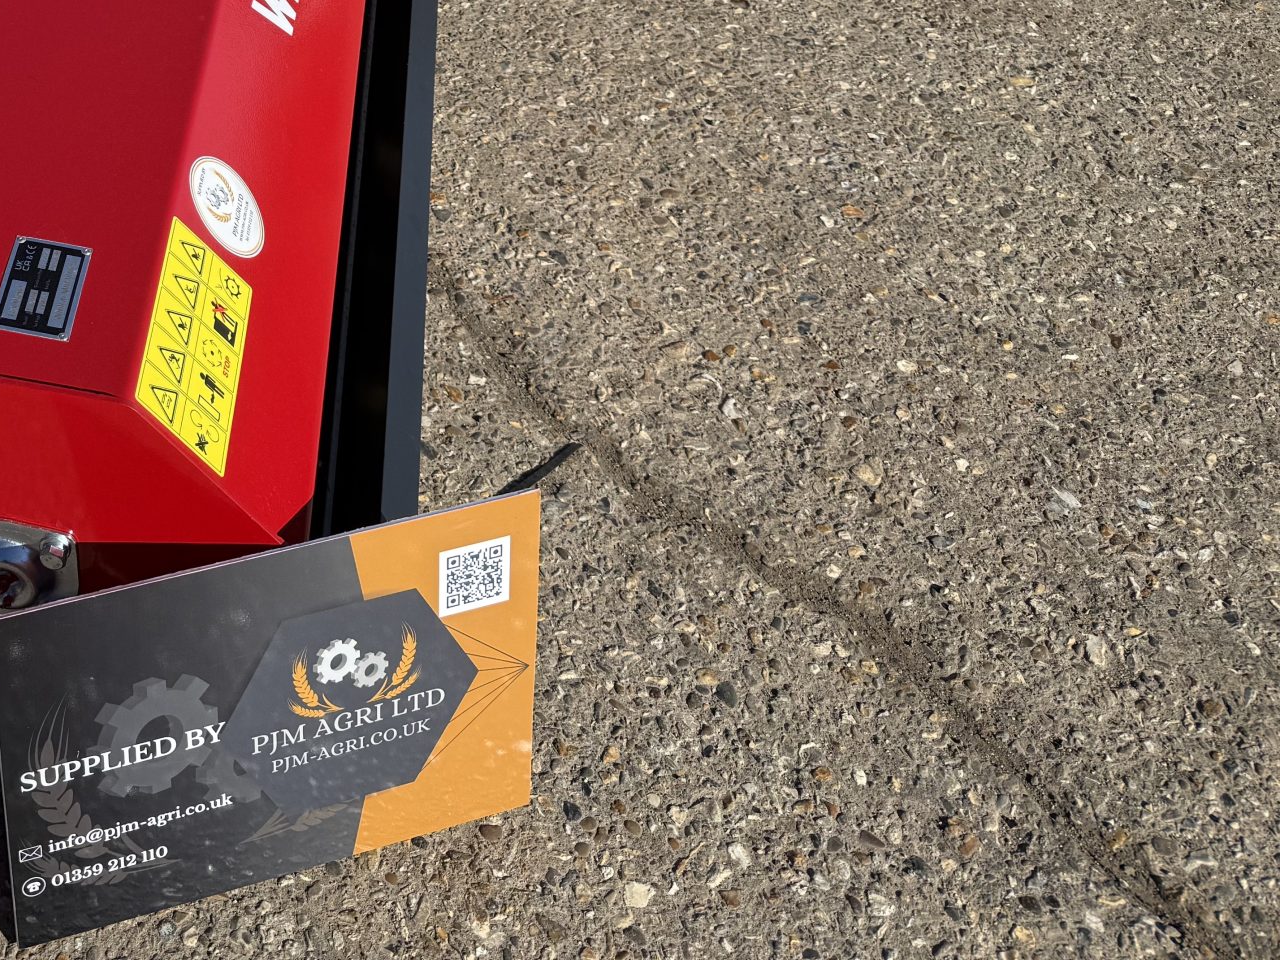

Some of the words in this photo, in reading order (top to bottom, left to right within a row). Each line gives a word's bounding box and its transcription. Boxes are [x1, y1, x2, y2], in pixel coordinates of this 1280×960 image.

[223, 355, 231, 378] STOP
[251, 723, 307, 756] PJM
[313, 702, 384, 739] AGRI
[391, 688, 446, 718] LTD
[271, 718, 431, 774] PJM-AGRI.CO.UK
[20, 736, 177, 793] SUPPLIED
[184, 721, 226, 751] BY
[48, 793, 234, 854] info@pjm-agri.co.uk
[51, 863, 104, 888] 01359
[108, 853, 138, 873] 212
[141, 845, 169, 864] 110
